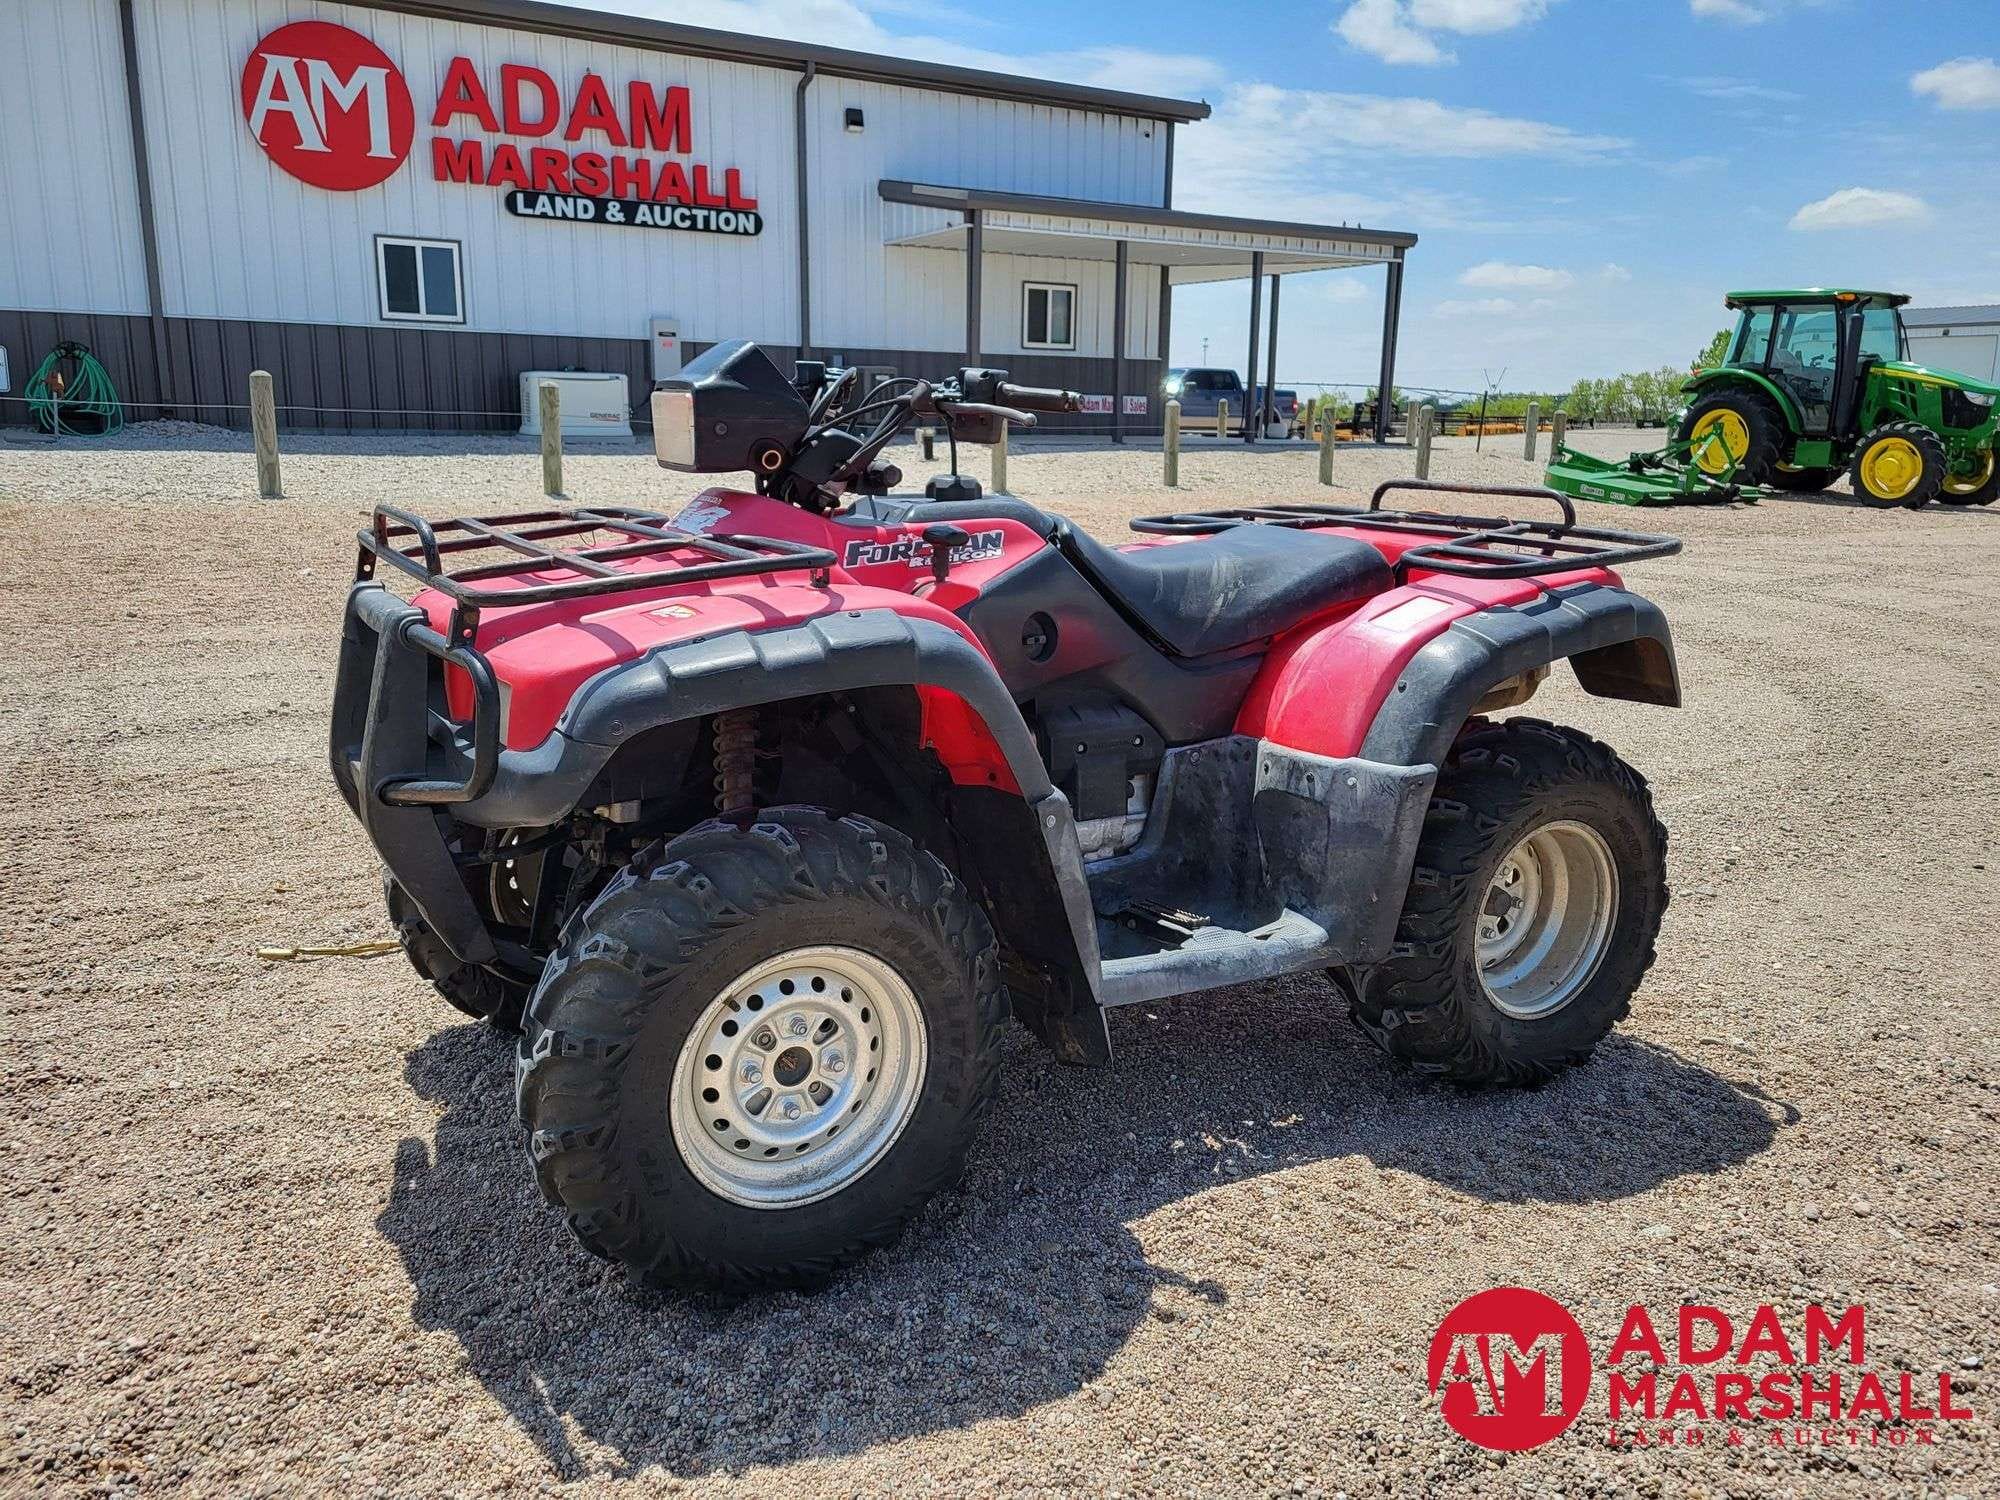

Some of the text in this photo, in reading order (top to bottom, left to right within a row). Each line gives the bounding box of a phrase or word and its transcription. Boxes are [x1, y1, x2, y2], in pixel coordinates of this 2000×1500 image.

[248, 53, 397, 160] AM
[431, 56, 692, 154] ADAM
[431, 137, 759, 210] MARSHALL
[516, 192, 757, 235] LAND & AUCTION
